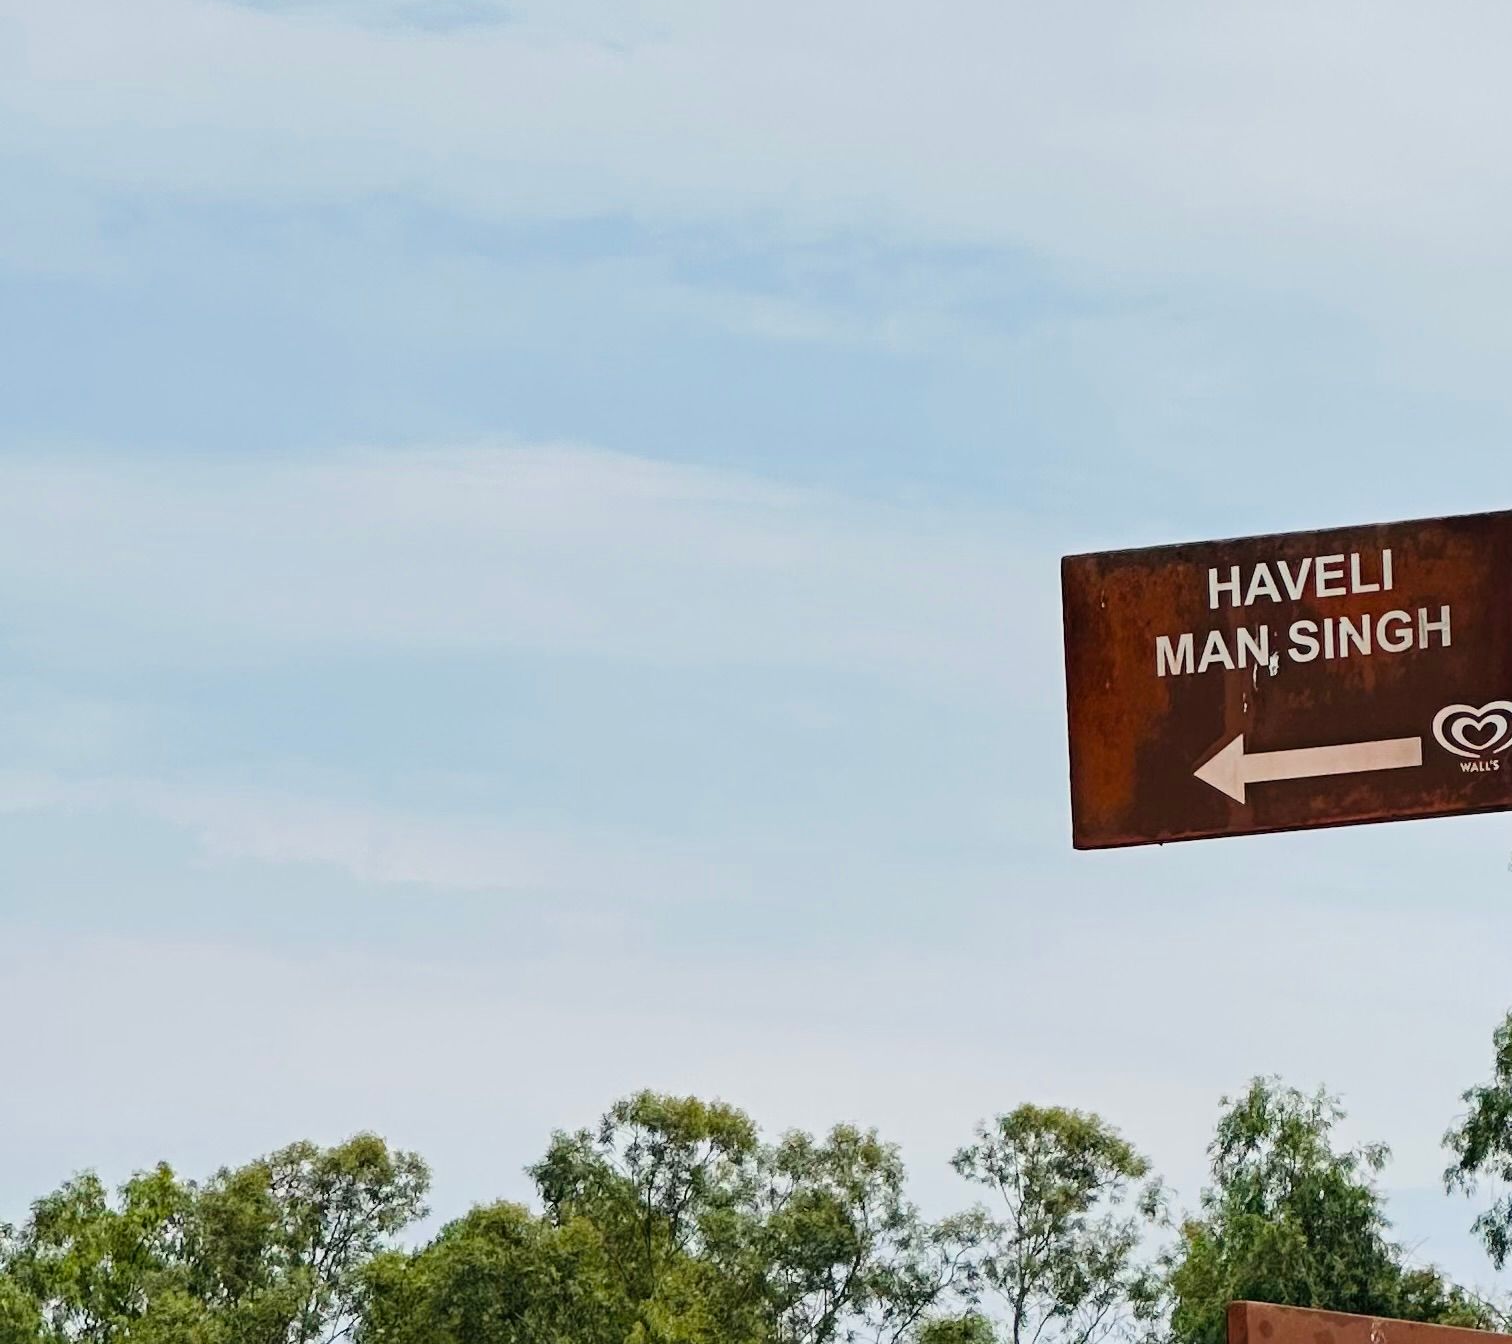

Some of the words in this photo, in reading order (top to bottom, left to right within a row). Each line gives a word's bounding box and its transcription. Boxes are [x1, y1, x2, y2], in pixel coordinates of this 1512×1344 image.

[1207, 549, 1393, 609] HAVELI
[1155, 624, 1271, 677] MAN
[1286, 605, 1452, 665] SINGH
[1459, 759, 1500, 773] WALL'S
